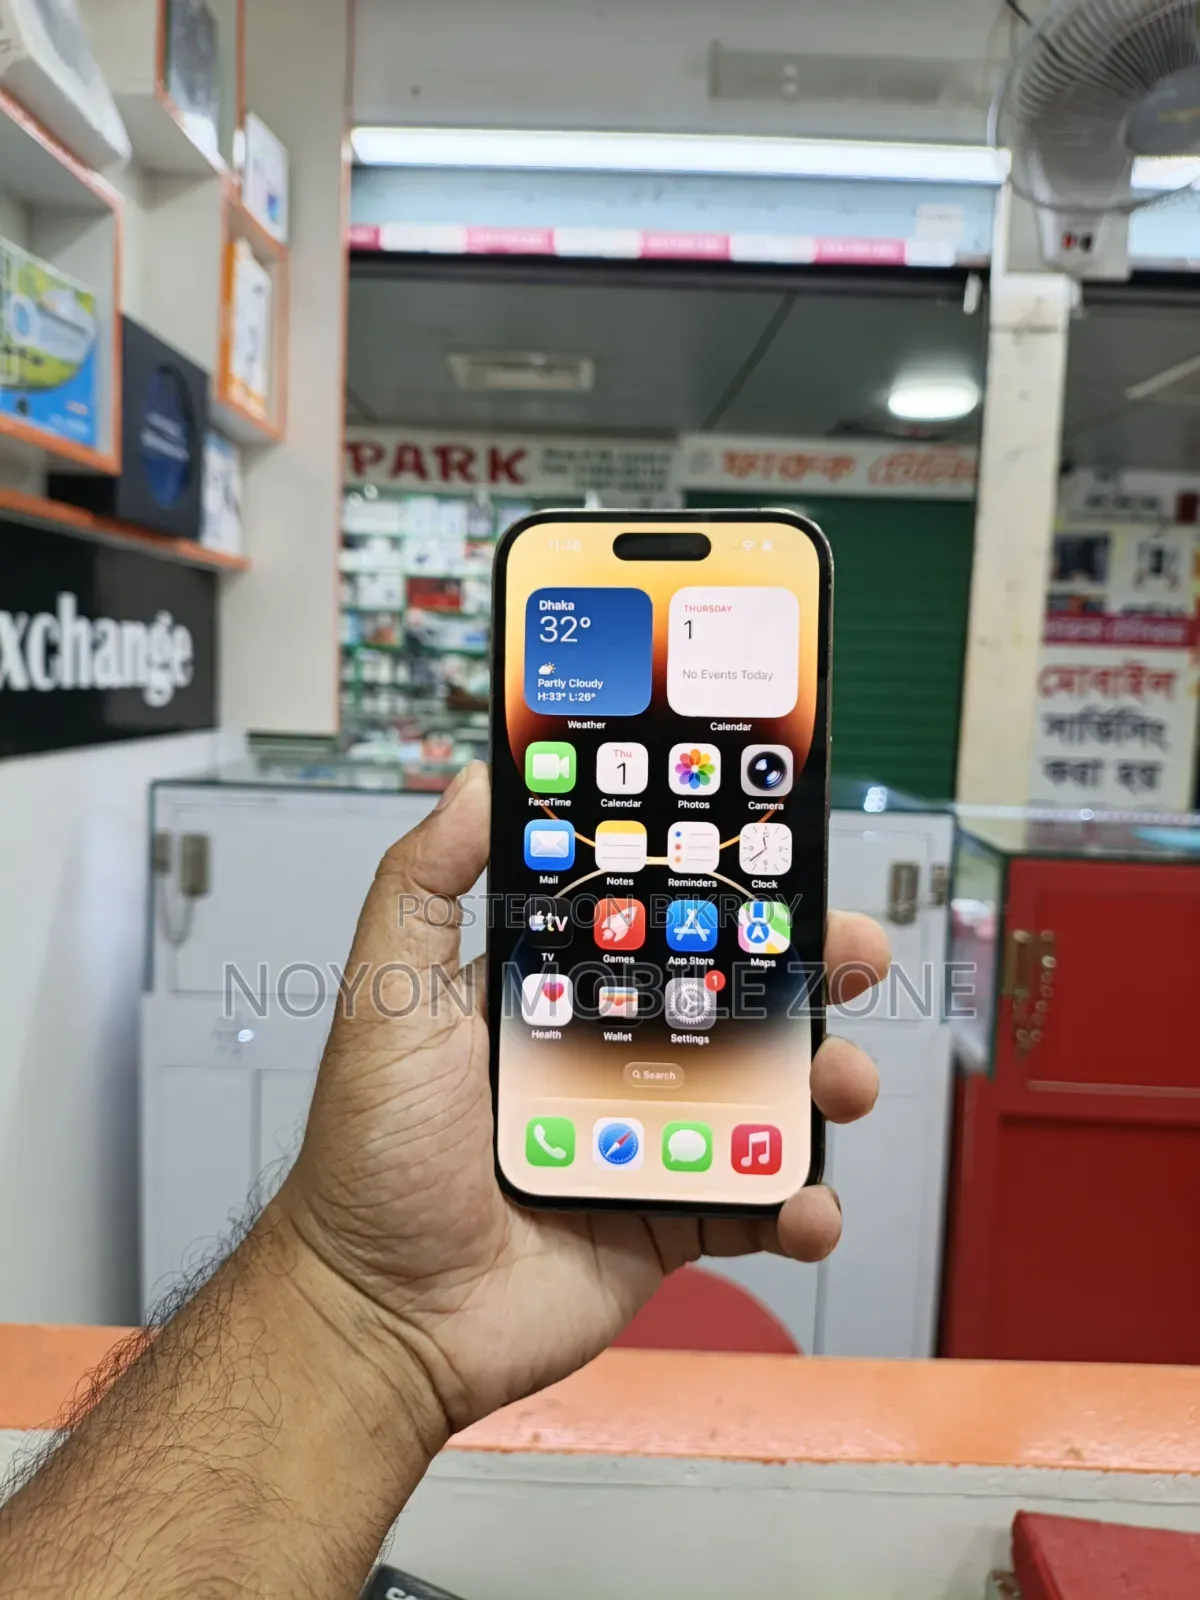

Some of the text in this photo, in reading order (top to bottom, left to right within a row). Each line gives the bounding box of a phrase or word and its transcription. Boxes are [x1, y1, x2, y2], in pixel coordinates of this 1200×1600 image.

[346, 440, 528, 486] PARK
[538, 599, 575, 611] Dhaka
[683, 604, 733, 613] THURSDAY
[683, 619, 693, 640] 1
[682, 669, 774, 682] No Events Today
[537, 677, 604, 691] Partly Cloudy
[567, 719, 607, 730] Weather
[709, 721, 753, 732] Calendar
[613, 748, 633, 759] Thu
[616, 762, 628, 786] 1
[527, 797, 572, 808] FaceTime
[600, 798, 643, 809] Calendar
[677, 799, 711, 810] Photos
[747, 800, 785, 811] Camera
[539, 874, 559, 885] Mail
[606, 876, 634, 886] Notes
[667, 877, 718, 888] Reminders
[750, 879, 778, 889] Clock
[541, 952, 555, 962] TV
[602, 954, 635, 965] Games
[667, 955, 715, 967] App Store
[749, 957, 777, 970] Maps
[531, 1029, 562, 1040] Health
[603, 1031, 633, 1042] Wallet
[669, 1032, 710, 1046] Settings
[643, 1069, 676, 1081] Search
